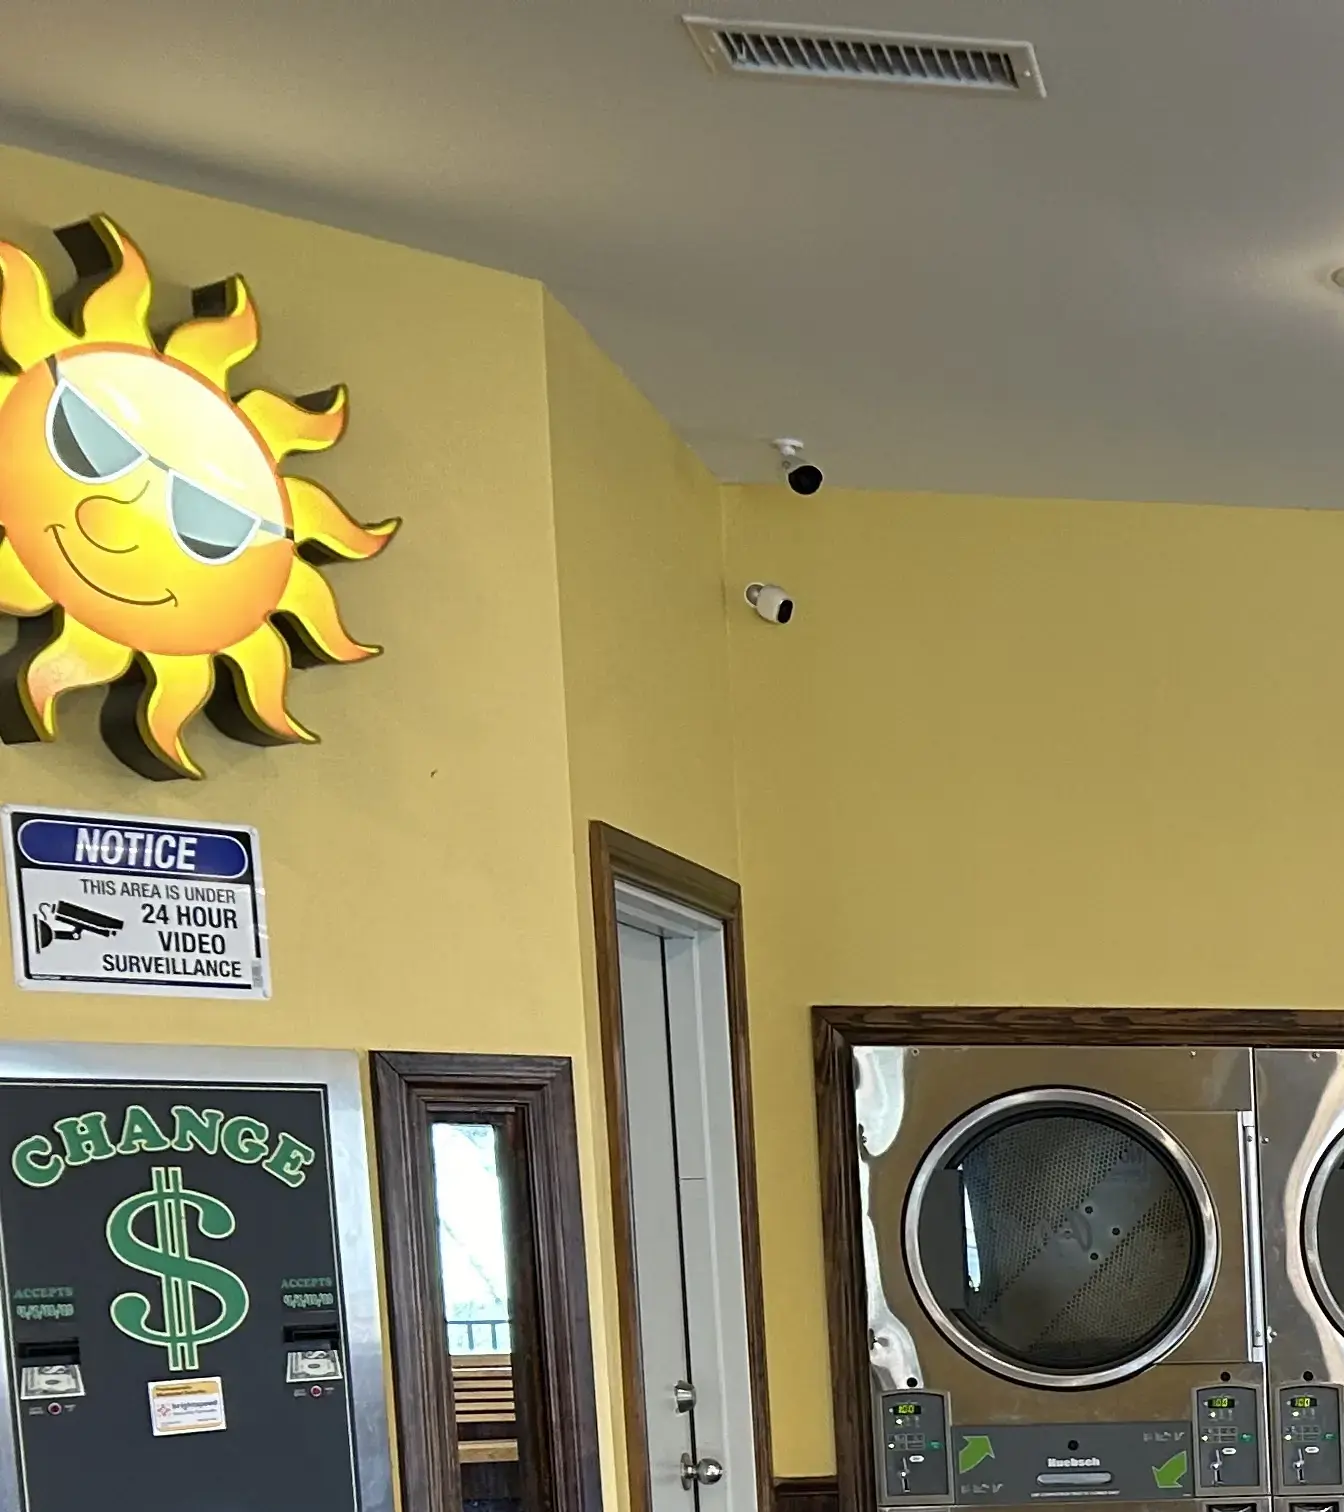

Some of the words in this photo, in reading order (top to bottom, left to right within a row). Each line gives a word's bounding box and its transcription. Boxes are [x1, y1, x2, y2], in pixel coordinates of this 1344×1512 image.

[75, 828, 198, 871] NOTICE
[81, 879, 115, 896] THIS
[120, 883, 161, 899] AREA
[166, 885, 180, 900] IS
[185, 887, 235, 903] UNDER
[141, 904, 169, 925] 24
[177, 906, 237, 929] HOUR
[158, 931, 225, 955] VIDEO
[103, 955, 242, 978] SURVEILLANCE
[12, 1105, 315, 1188] CHANGE
